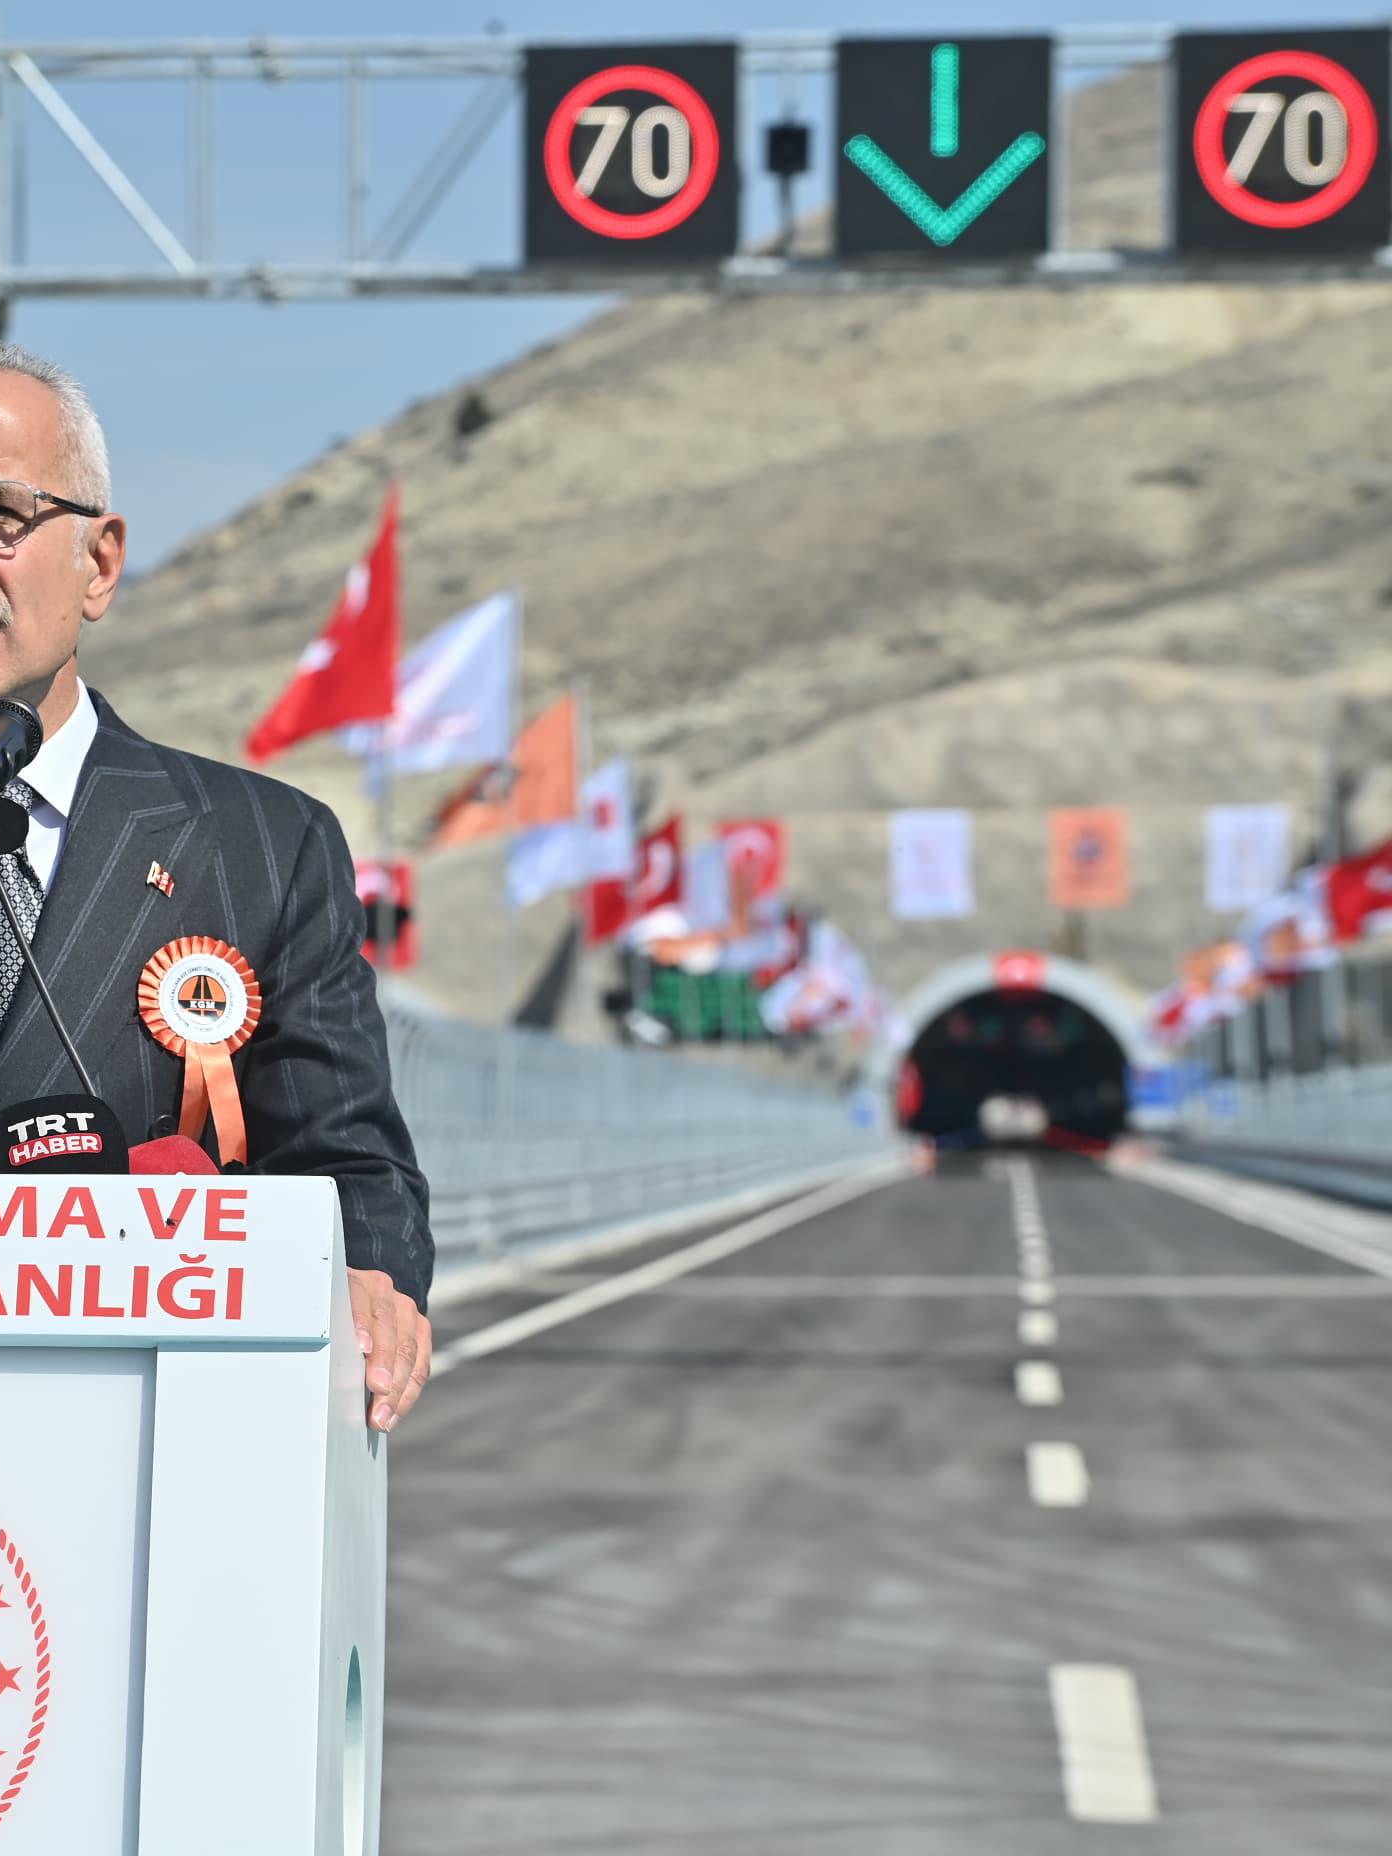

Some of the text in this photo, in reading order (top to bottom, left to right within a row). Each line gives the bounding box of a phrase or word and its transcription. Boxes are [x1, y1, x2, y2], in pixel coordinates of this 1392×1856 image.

[572, 104, 693, 198] 70
[1224, 90, 1350, 188] 70
[189, 1000, 216, 1009] KGM
[7, 1112, 95, 1143] TRT
[12, 1135, 99, 1163] HABER
[139, 1187, 248, 1242] VE
